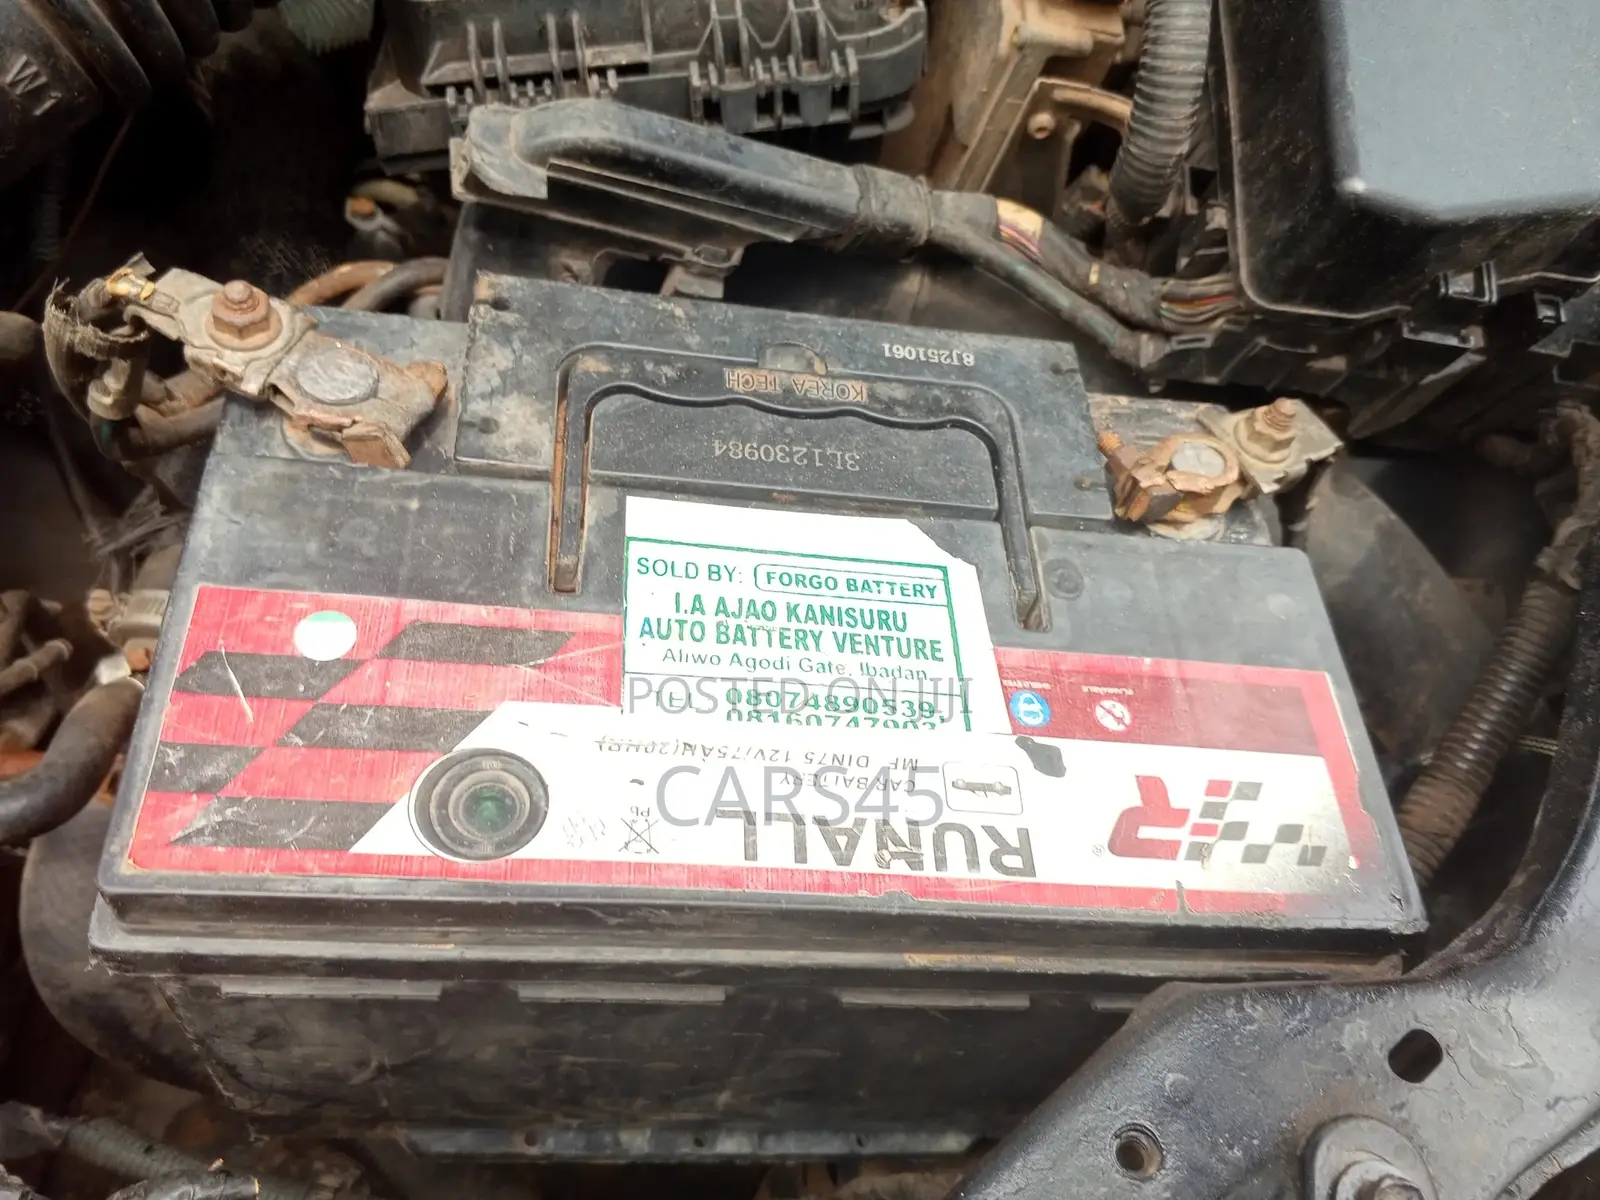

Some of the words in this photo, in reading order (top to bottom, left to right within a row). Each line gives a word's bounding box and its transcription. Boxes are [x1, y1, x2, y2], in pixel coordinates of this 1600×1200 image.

[881, 343, 976, 367] 8J251061
[725, 370, 779, 393] TECH
[792, 377, 866, 402] KOREA
[712, 438, 861, 471] 3L1230984
[637, 556, 699, 579] SOLD
[707, 563, 743, 584] BY:
[766, 571, 838, 591] FORGO
[846, 578, 938, 600] BATTERY
[674, 592, 706, 616] I.A
[715, 596, 777, 622] AJAO
[786, 602, 908, 633] KANISURU
[640, 617, 706, 642] AUTO
[716, 623, 823, 652] BATTERY
[832, 632, 945, 662] VENTURE
[662, 648, 721, 666] Aliwo
[729, 652, 791, 674] Agodi
[804, 752, 870, 769] DIN75
[888, 757, 919, 771] MF
[876, 778, 916, 793] CAR
[629, 805, 652, 818] Pb
[714, 808, 1037, 878] RUNALL
